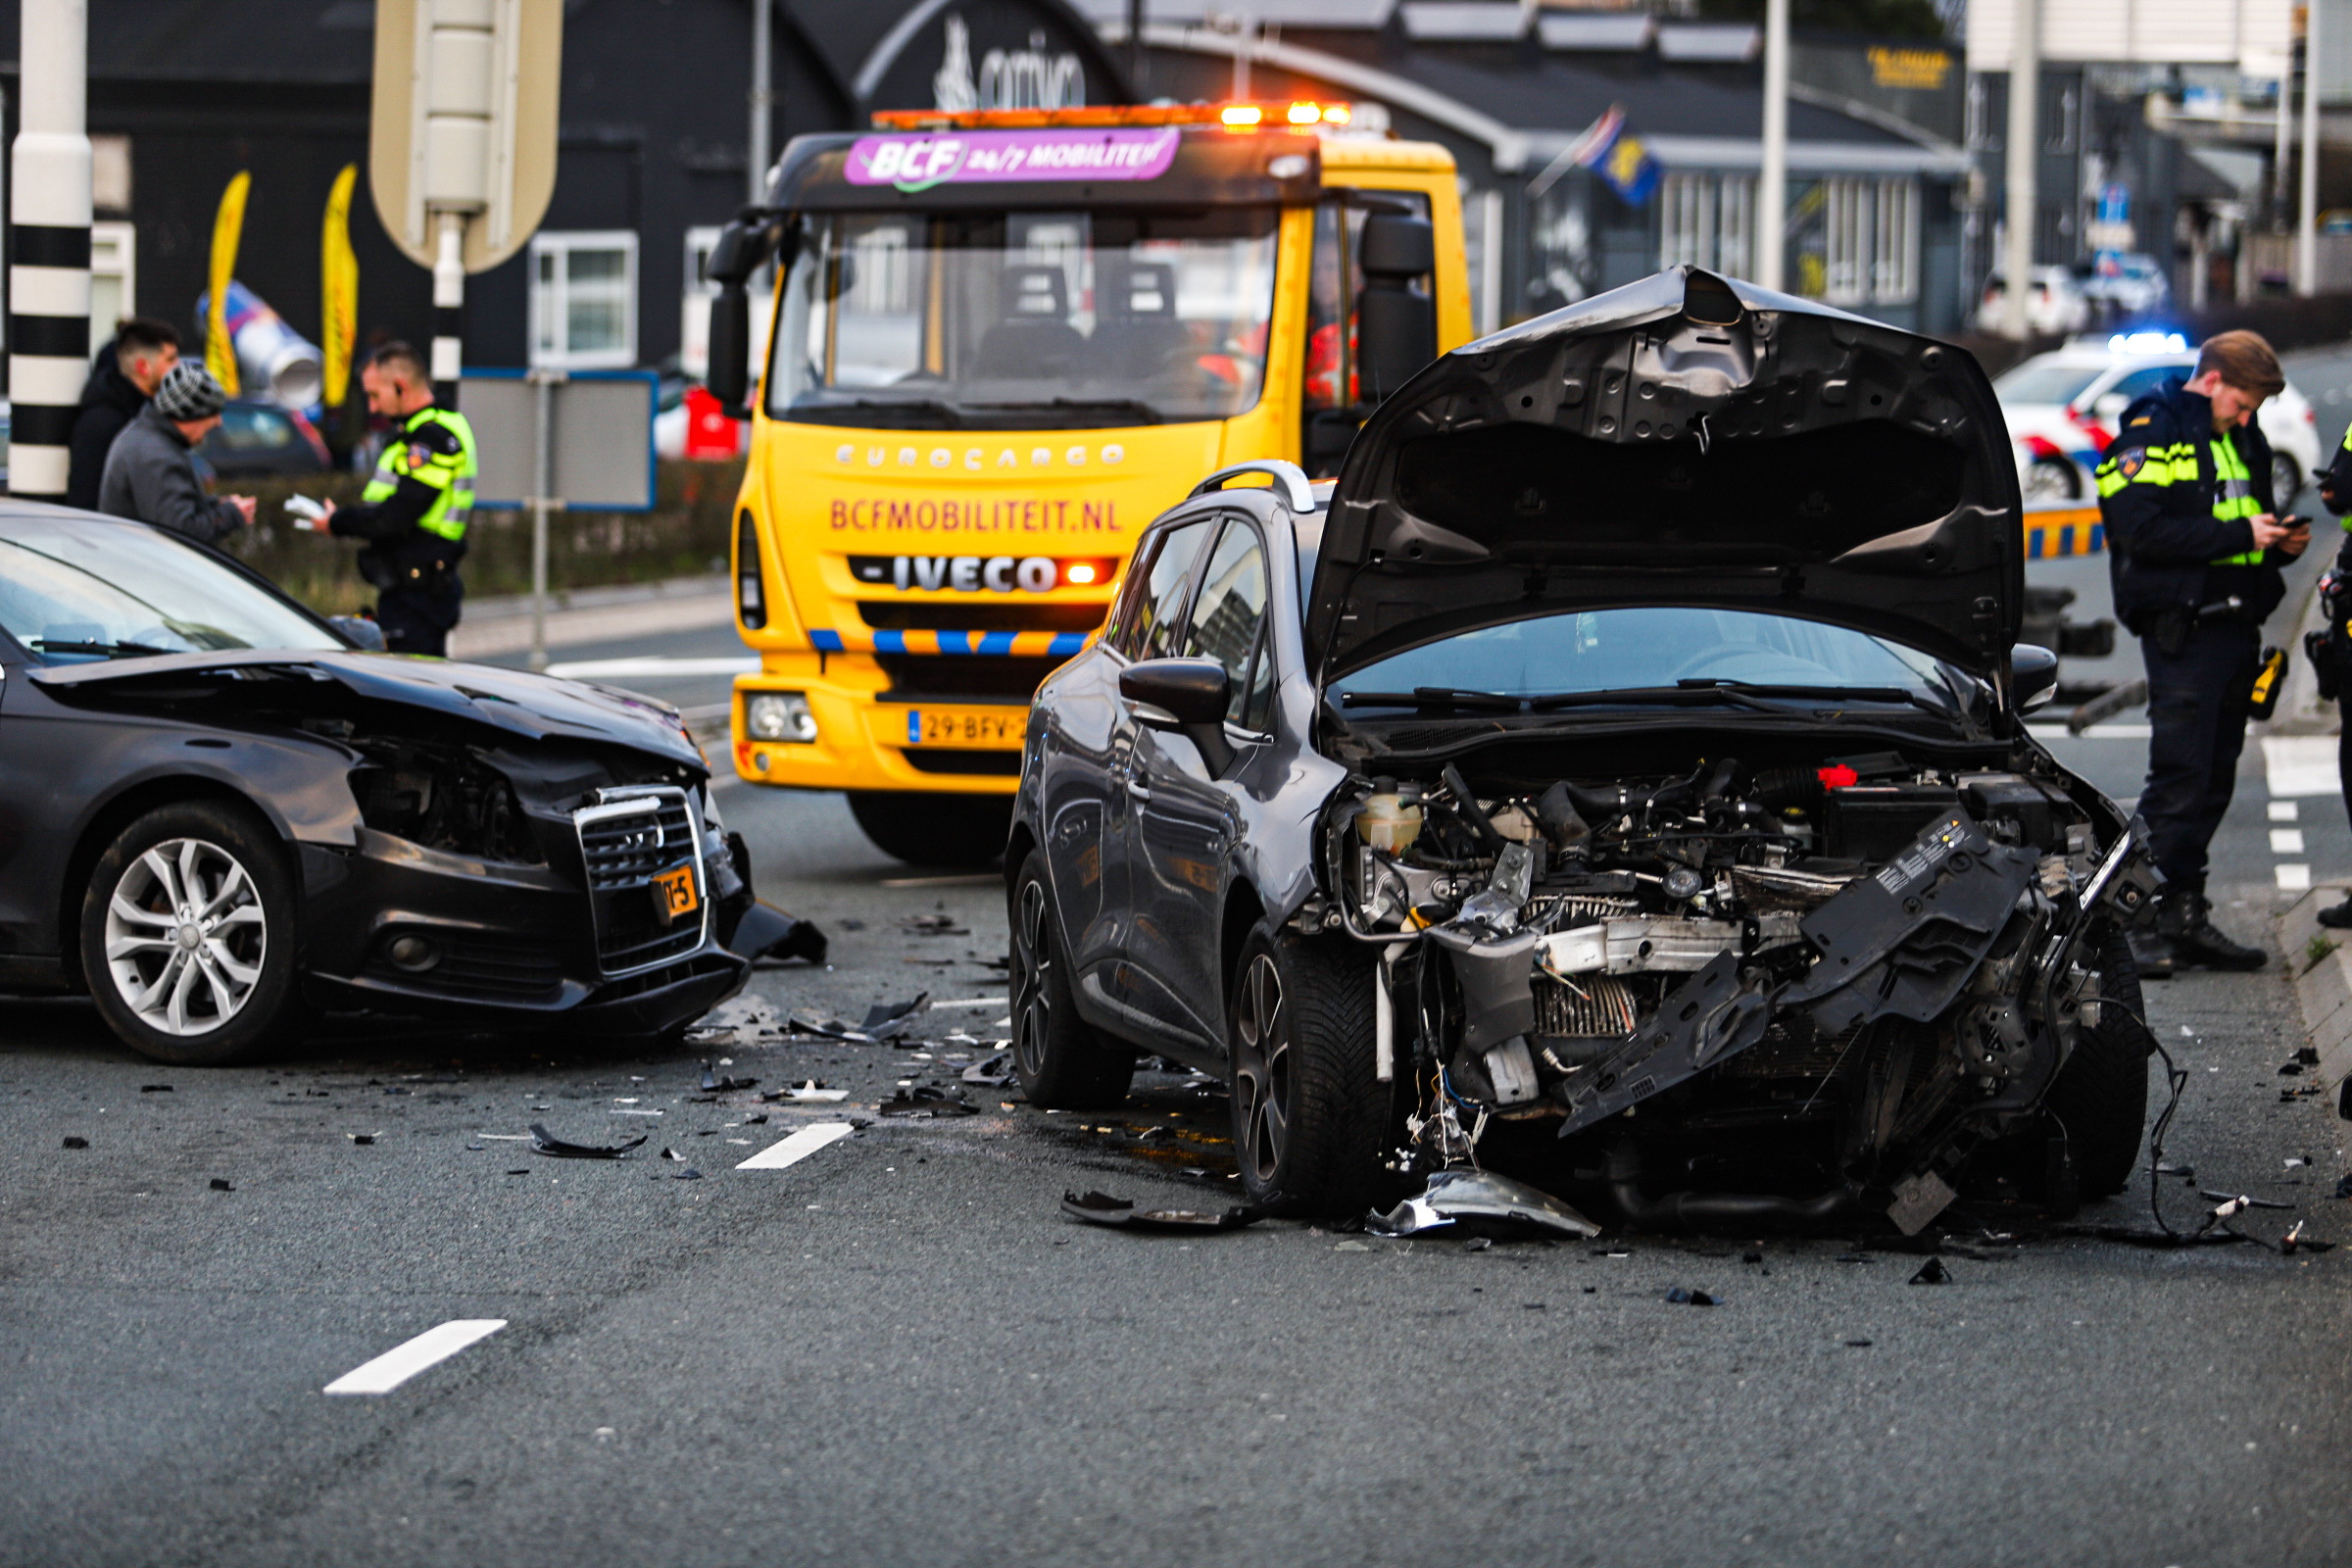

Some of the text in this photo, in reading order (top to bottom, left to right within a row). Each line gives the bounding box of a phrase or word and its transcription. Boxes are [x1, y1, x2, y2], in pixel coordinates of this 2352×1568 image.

[868, 138, 1163, 179] BCF 24/7 MOBILITEIT
[836, 444, 1124, 470] EUROCARGO
[830, 499, 1123, 532] BCFMOBILITEIT.NL
[893, 555, 1057, 593] IVECO
